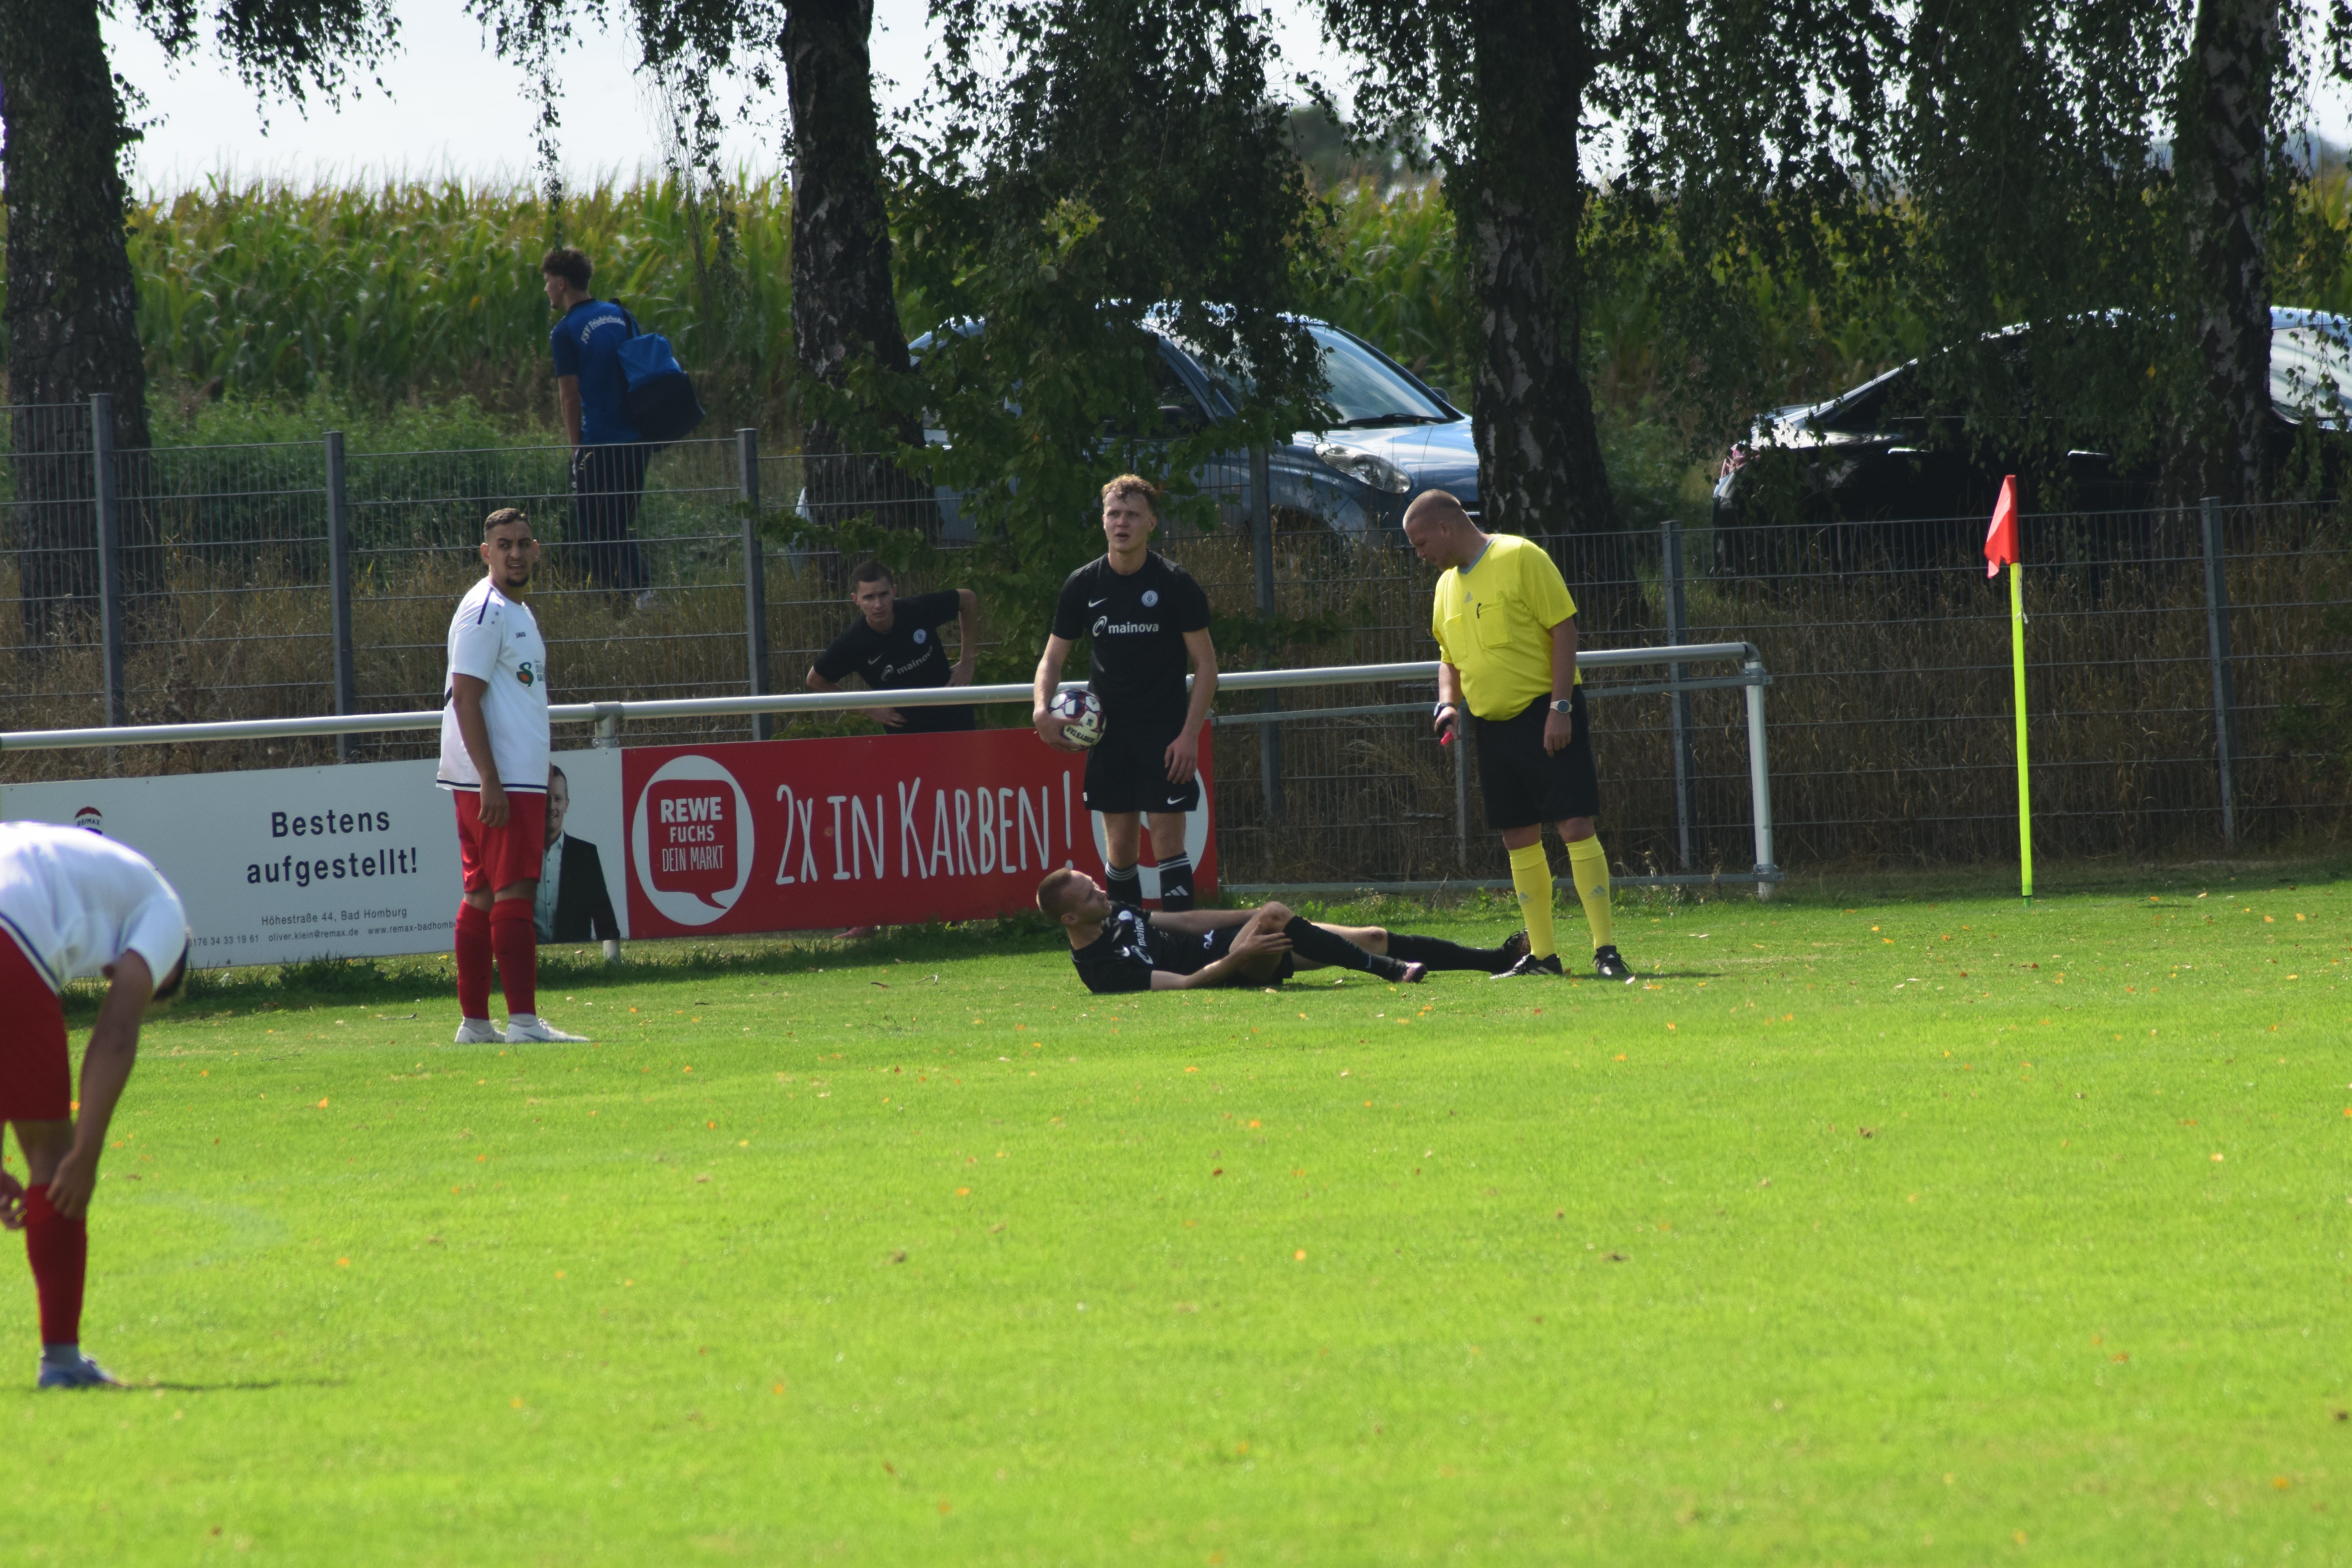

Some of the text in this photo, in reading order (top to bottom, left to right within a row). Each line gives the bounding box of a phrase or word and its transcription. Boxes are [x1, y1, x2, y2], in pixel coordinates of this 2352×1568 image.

[1108, 621, 1159, 634] mainova
[271, 809, 390, 837] Bestens
[661, 797, 722, 823] REWE
[670, 825, 715, 843] FUCHS
[827, 795, 884, 880] IN
[247, 847, 417, 887] aufgestellt!
[662, 845, 723, 872] DEIN MARKT
[261, 908, 407, 926] Höhestraße 44, Bad Homburg
[211, 937, 220, 945] 34
[237, 935, 246, 944] 19
[250, 935, 259, 943] 61
[268, 927, 358, 942] oliver.klein@remax.de
